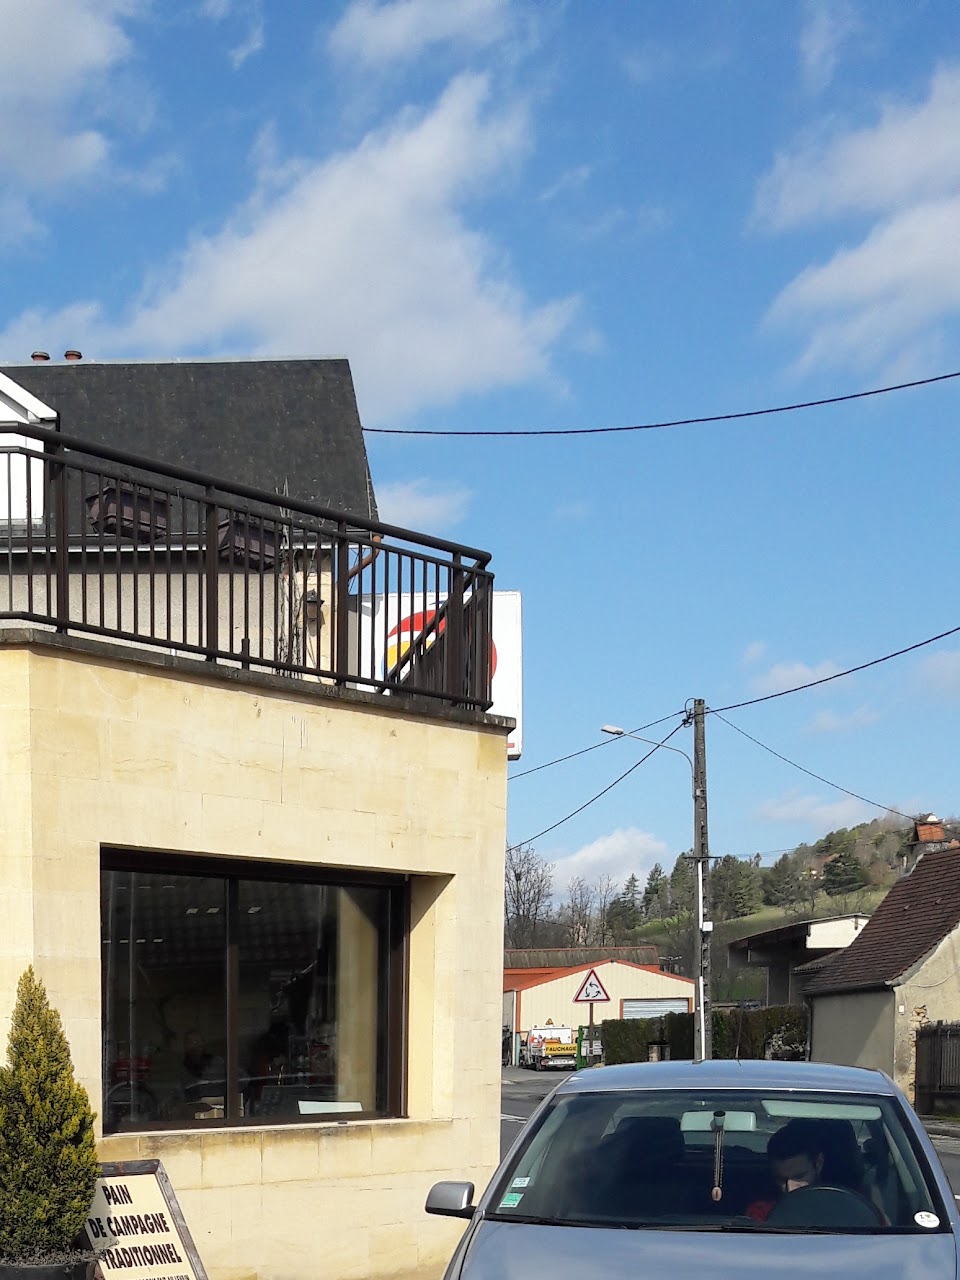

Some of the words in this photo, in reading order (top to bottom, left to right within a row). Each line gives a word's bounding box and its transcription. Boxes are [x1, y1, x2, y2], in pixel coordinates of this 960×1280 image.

[545, 1045, 577, 1053] FAUCHAGE
[101, 1184, 134, 1206] PAIN
[87, 1217, 108, 1239] DE
[107, 1212, 171, 1237] CAMPAGNE
[103, 1243, 183, 1270] TRADITIONNEL
